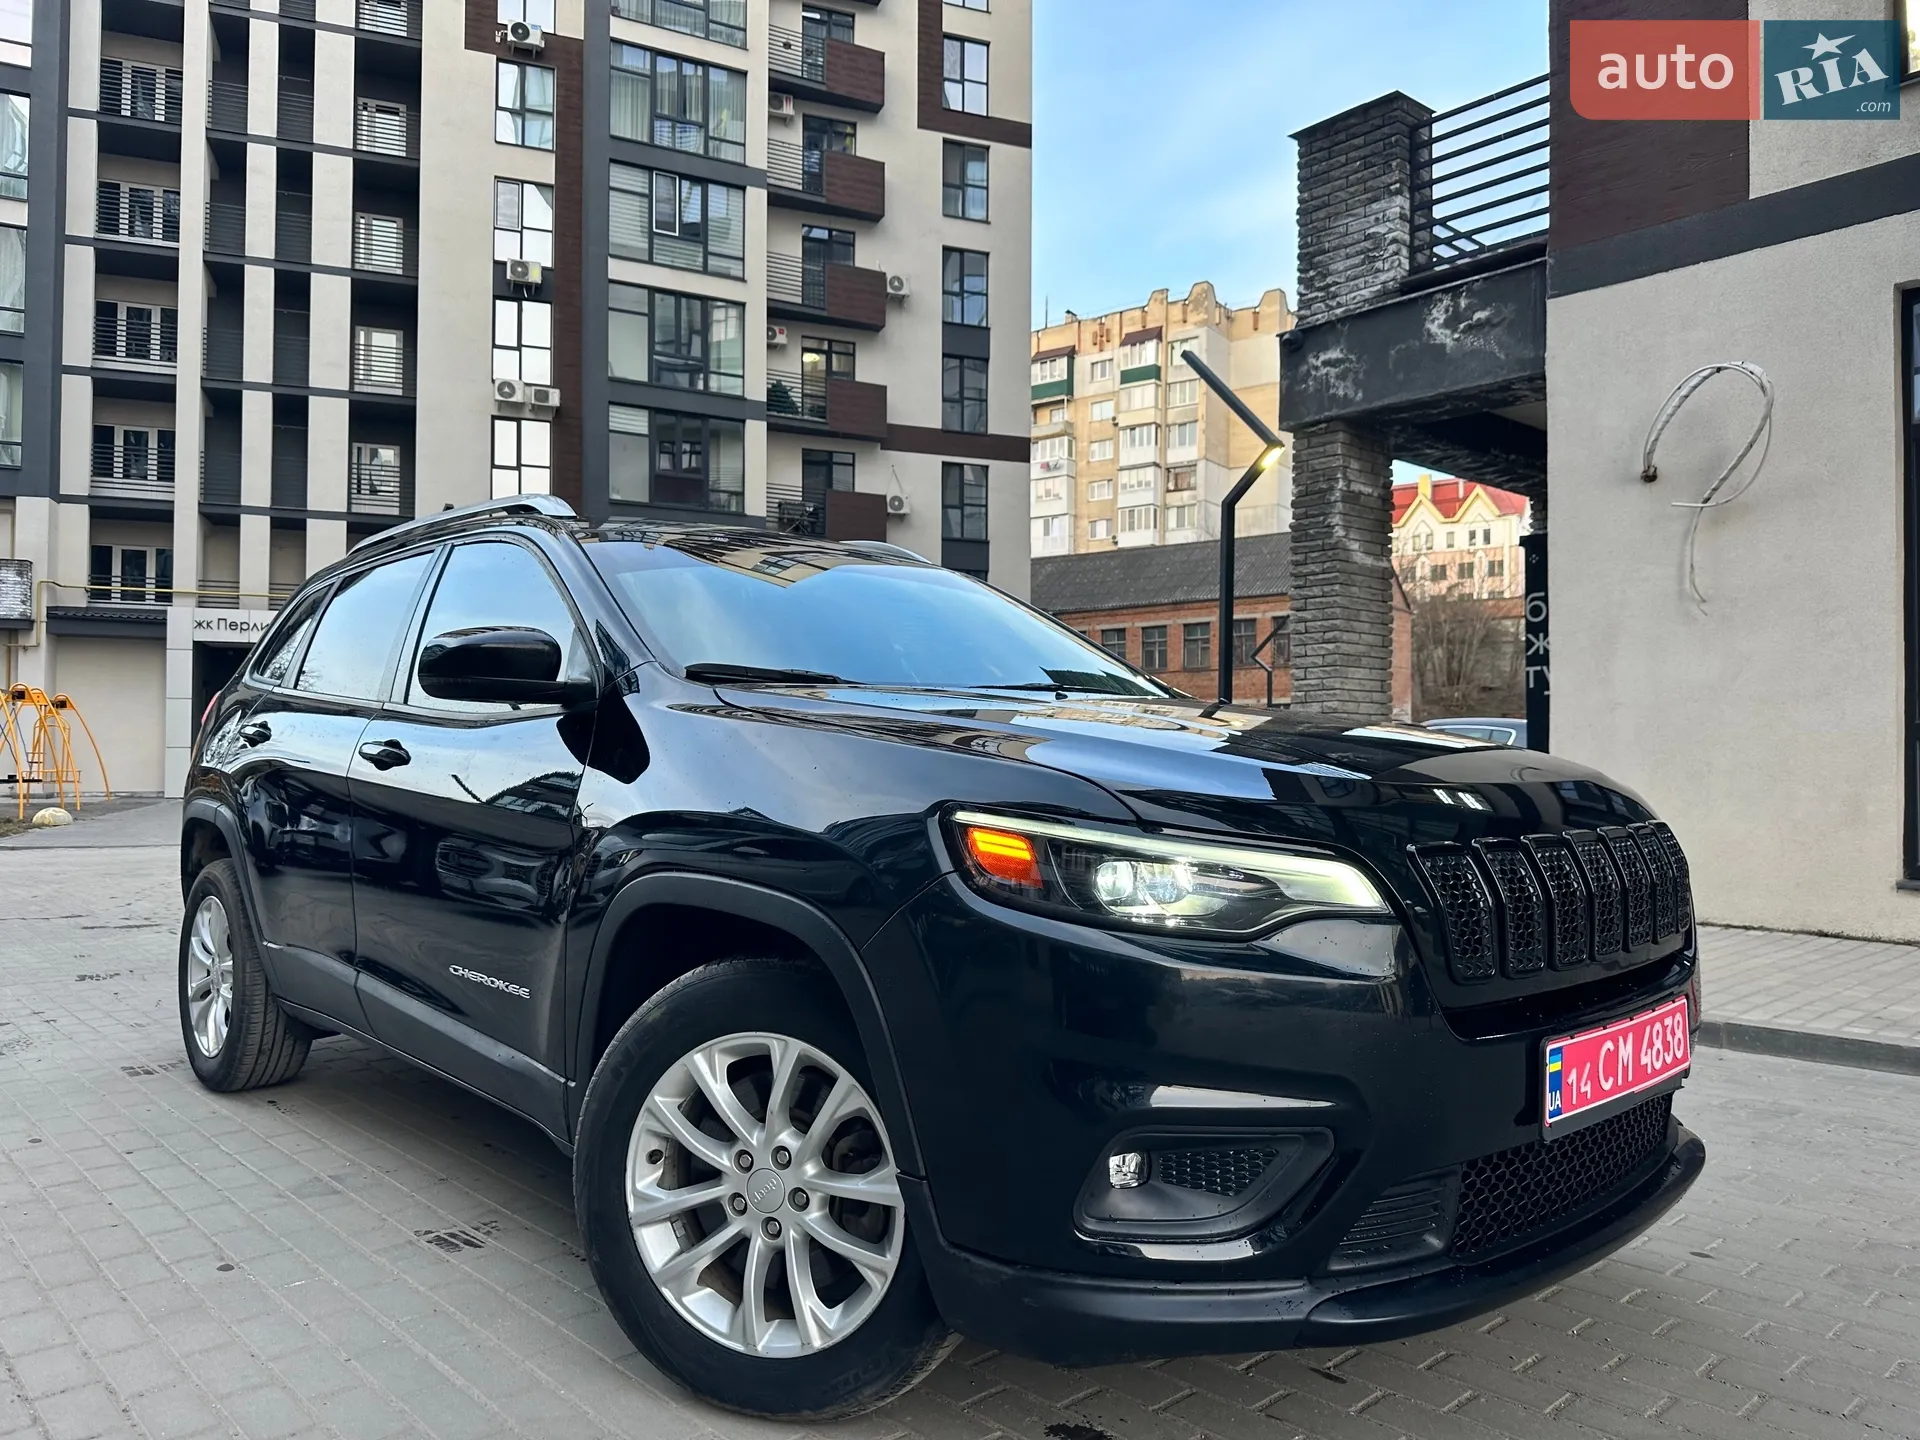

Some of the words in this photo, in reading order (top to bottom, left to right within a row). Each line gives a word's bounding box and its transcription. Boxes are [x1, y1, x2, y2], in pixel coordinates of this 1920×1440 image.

[448, 964, 531, 999] CHEROKEE
[1567, 1062, 1591, 1105] 14
[1598, 1032, 1633, 1091] CM
[1640, 1012, 1684, 1075] 4838
[1548, 1089, 1562, 1111] UA
[753, 1178, 777, 1203] Jeep
